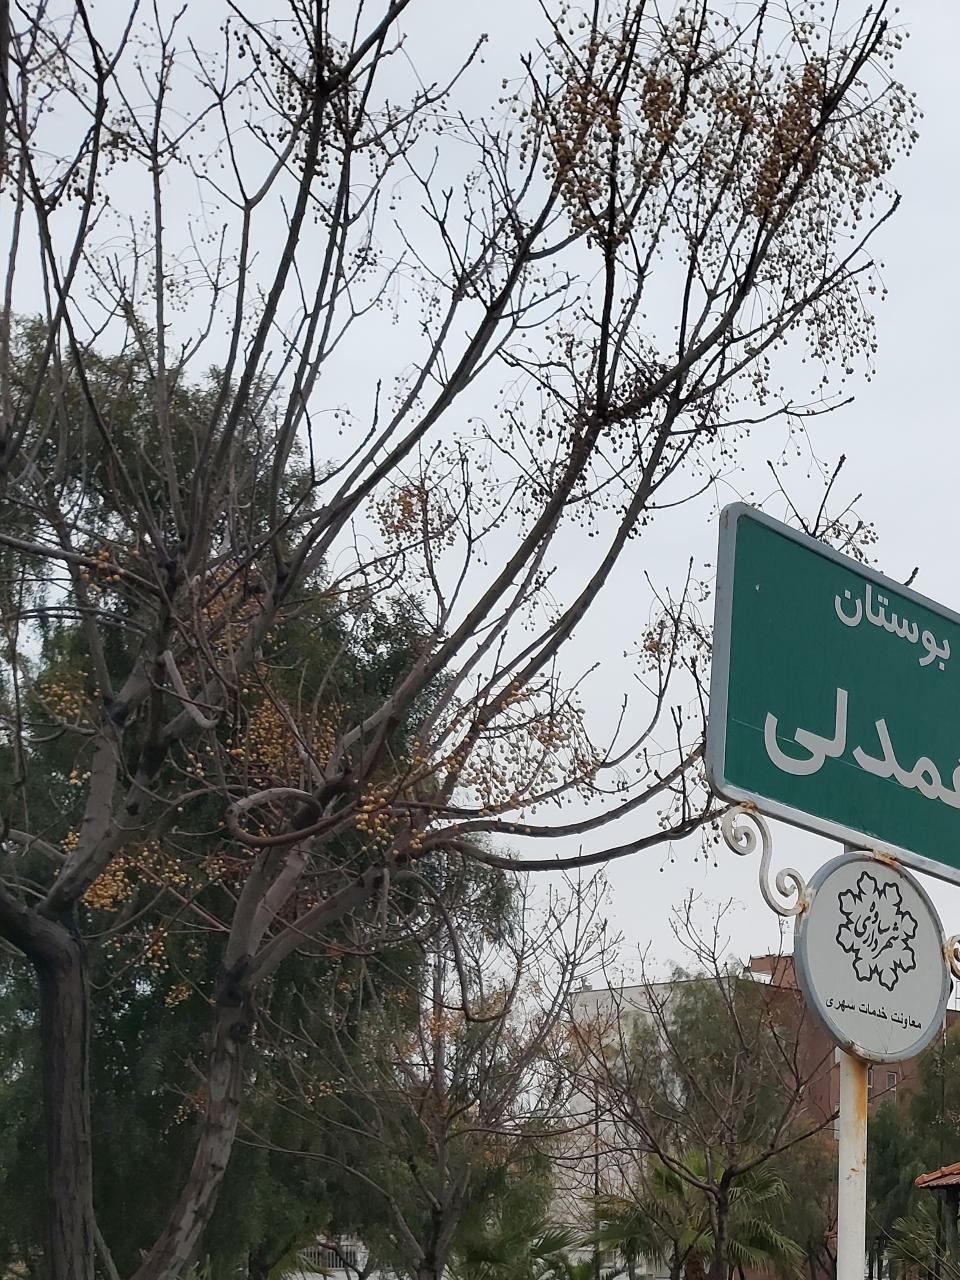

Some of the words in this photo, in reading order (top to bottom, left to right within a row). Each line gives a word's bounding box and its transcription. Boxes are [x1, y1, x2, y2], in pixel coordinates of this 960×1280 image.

[835, 584, 950, 671] بوستان
[858, 1003, 888, 1019] خدمات
[890, 1012, 922, 1029] معاونت
